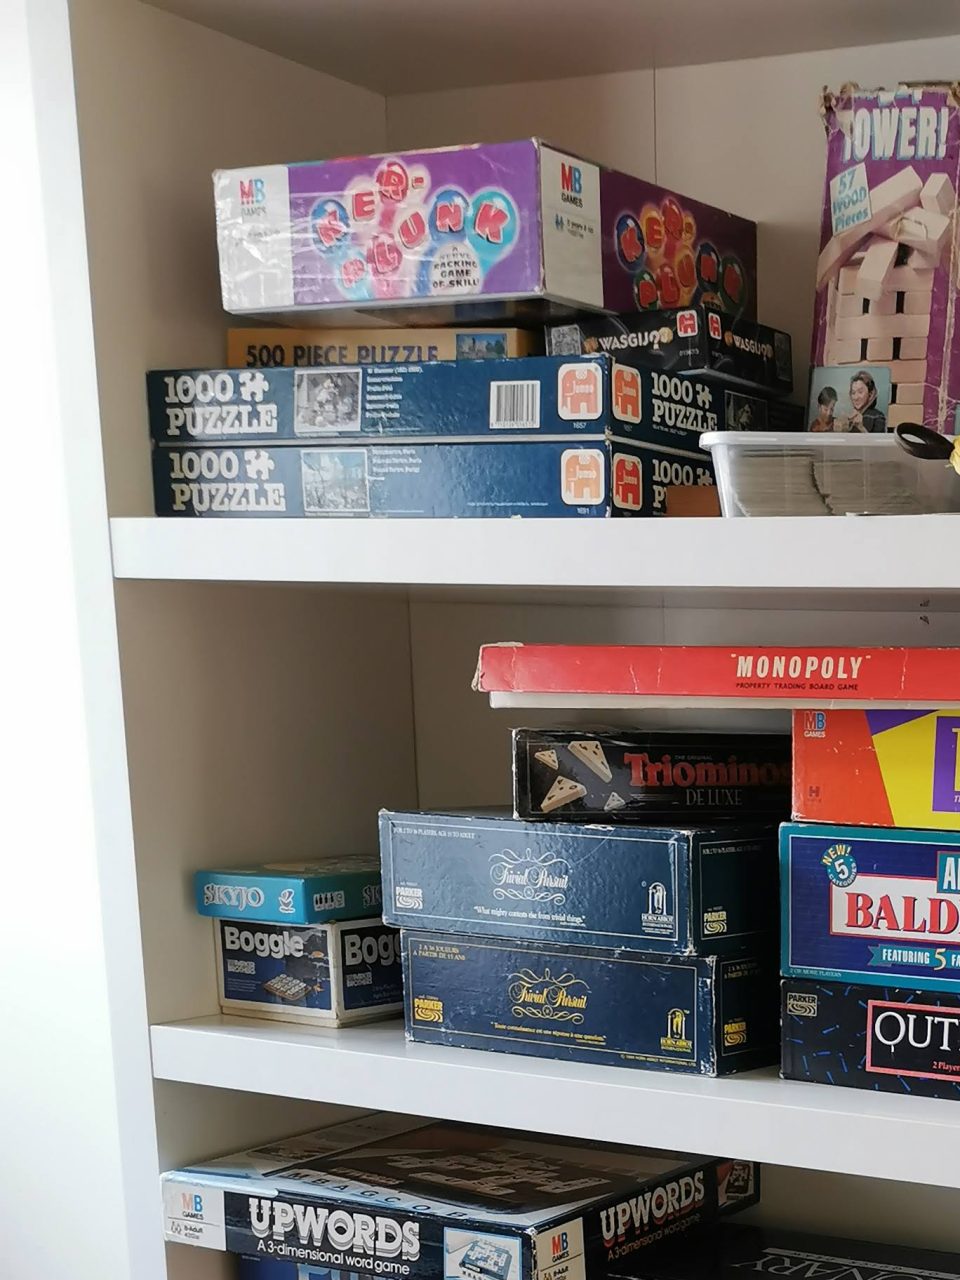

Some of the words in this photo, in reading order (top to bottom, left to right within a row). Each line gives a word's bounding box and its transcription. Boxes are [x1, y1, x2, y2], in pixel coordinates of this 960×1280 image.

[561, 162, 582, 194] MB
[838, 169, 857, 195] 57
[240, 178, 266, 206] MB
[561, 191, 583, 208] GAMES
[832, 187, 868, 213] WOOD
[834, 206, 868, 232] Pieces
[440, 269, 471, 278] GAME
[246, 345, 285, 367] 500
[292, 345, 347, 367] PIECE
[164, 374, 234, 404] 1000
[651, 372, 693, 403] 1000
[166, 403, 278, 436] PUZZLE
[651, 401, 718, 433] PUZZLE
[169, 451, 239, 479] 1000
[652, 459, 693, 486] 1000
[170, 482, 286, 512] PUZZLE
[735, 655, 863, 679] MONOPOLY
[736, 682, 770, 690] PROPERTY
[809, 683, 835, 691] BOARD
[803, 711, 826, 731] MB
[803, 730, 826, 738] GAMES
[822, 844, 852, 866] NEW!
[834, 858, 849, 880] 5
[203, 882, 265, 911] SKYJO
[704, 911, 727, 922] PARKER
[223, 925, 305, 959] Boggle
[882, 947, 930, 965] FEATURING
[933, 947, 947, 971] 5
[414, 998, 443, 1010] PARKER
[789, 994, 816, 1004] PARKER
[932, 1061, 938, 1069] 2
[181, 1192, 203, 1213] MB
[600, 1170, 704, 1244] UPWORDS
[182, 1211, 205, 1221] GAMES
[249, 1196, 421, 1261] UPWORDS
[551, 1231, 568, 1255] MB
[257, 1239, 267, 1251] A
[266, 1241, 344, 1265] 3-dimensional
[345, 1254, 374, 1270] word
[375, 1260, 410, 1275] game
[552, 1250, 570, 1263] GAMES
